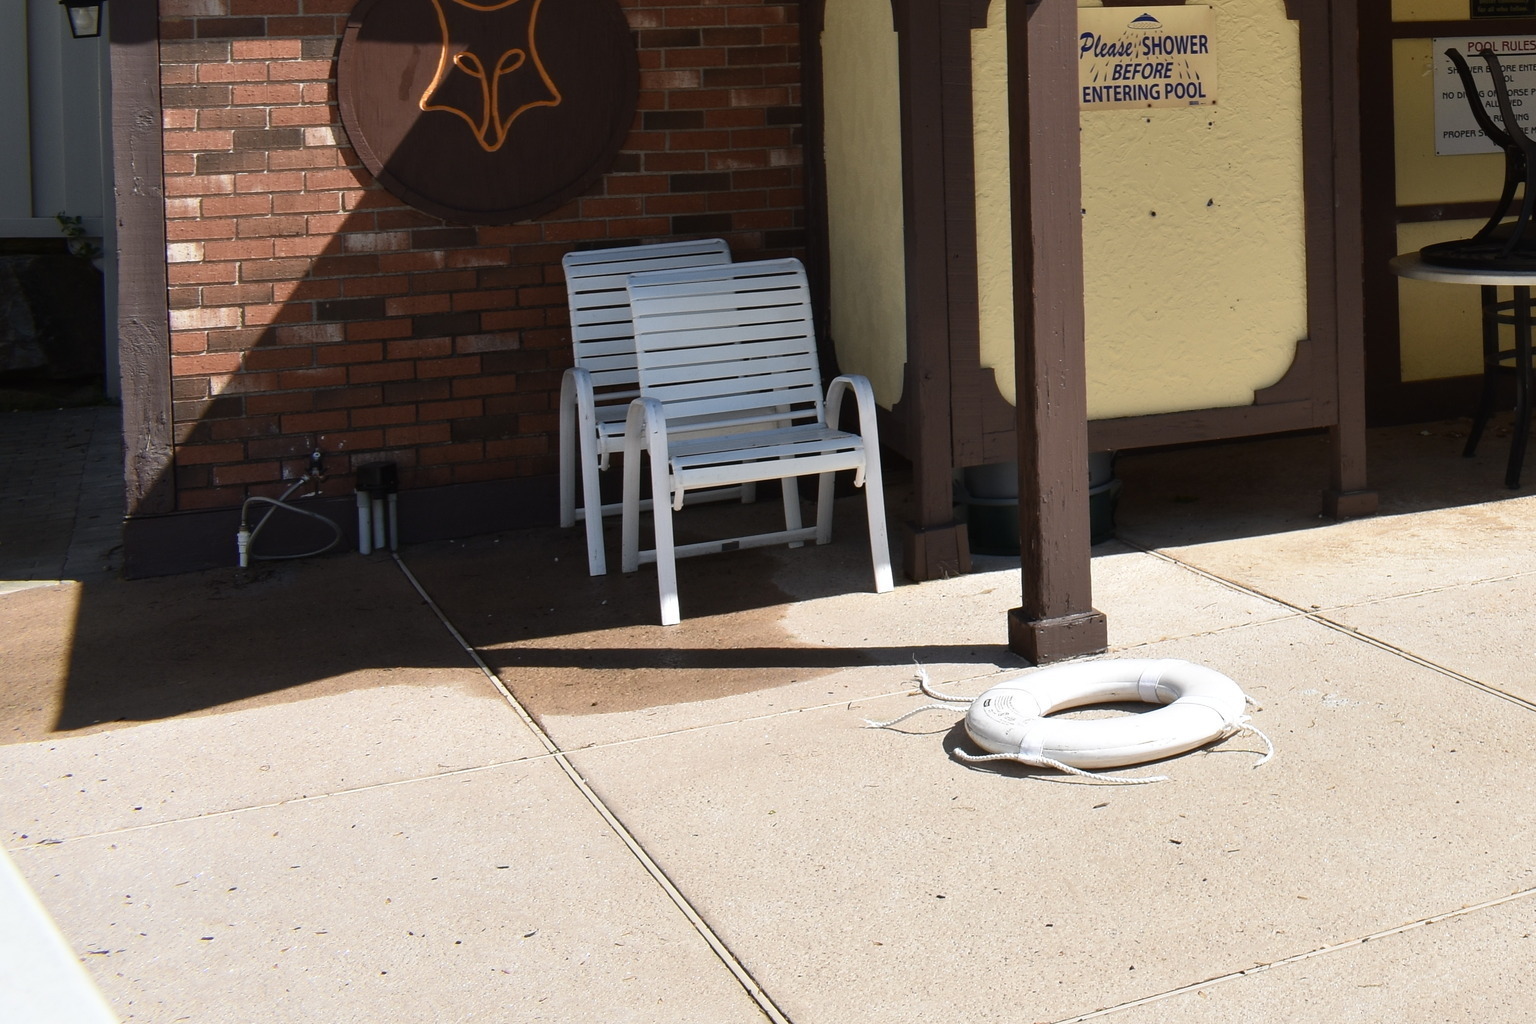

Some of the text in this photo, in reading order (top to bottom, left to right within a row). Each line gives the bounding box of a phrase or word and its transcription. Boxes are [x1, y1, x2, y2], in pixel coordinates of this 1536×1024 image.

[1079, 32, 1209, 60] Please SHOWER
[1467, 40, 1536, 52] POOL RULES
[1111, 62, 1174, 81] BEFORE
[1486, 64, 1516, 73] BORE
[1082, 82, 1207, 103] ENTERING POOL
[1442, 91, 1455, 99] NO
[1507, 88, 1529, 97] ORSE
[1485, 99, 1523, 108] ALLED
[1443, 129, 1477, 138] PROPER
